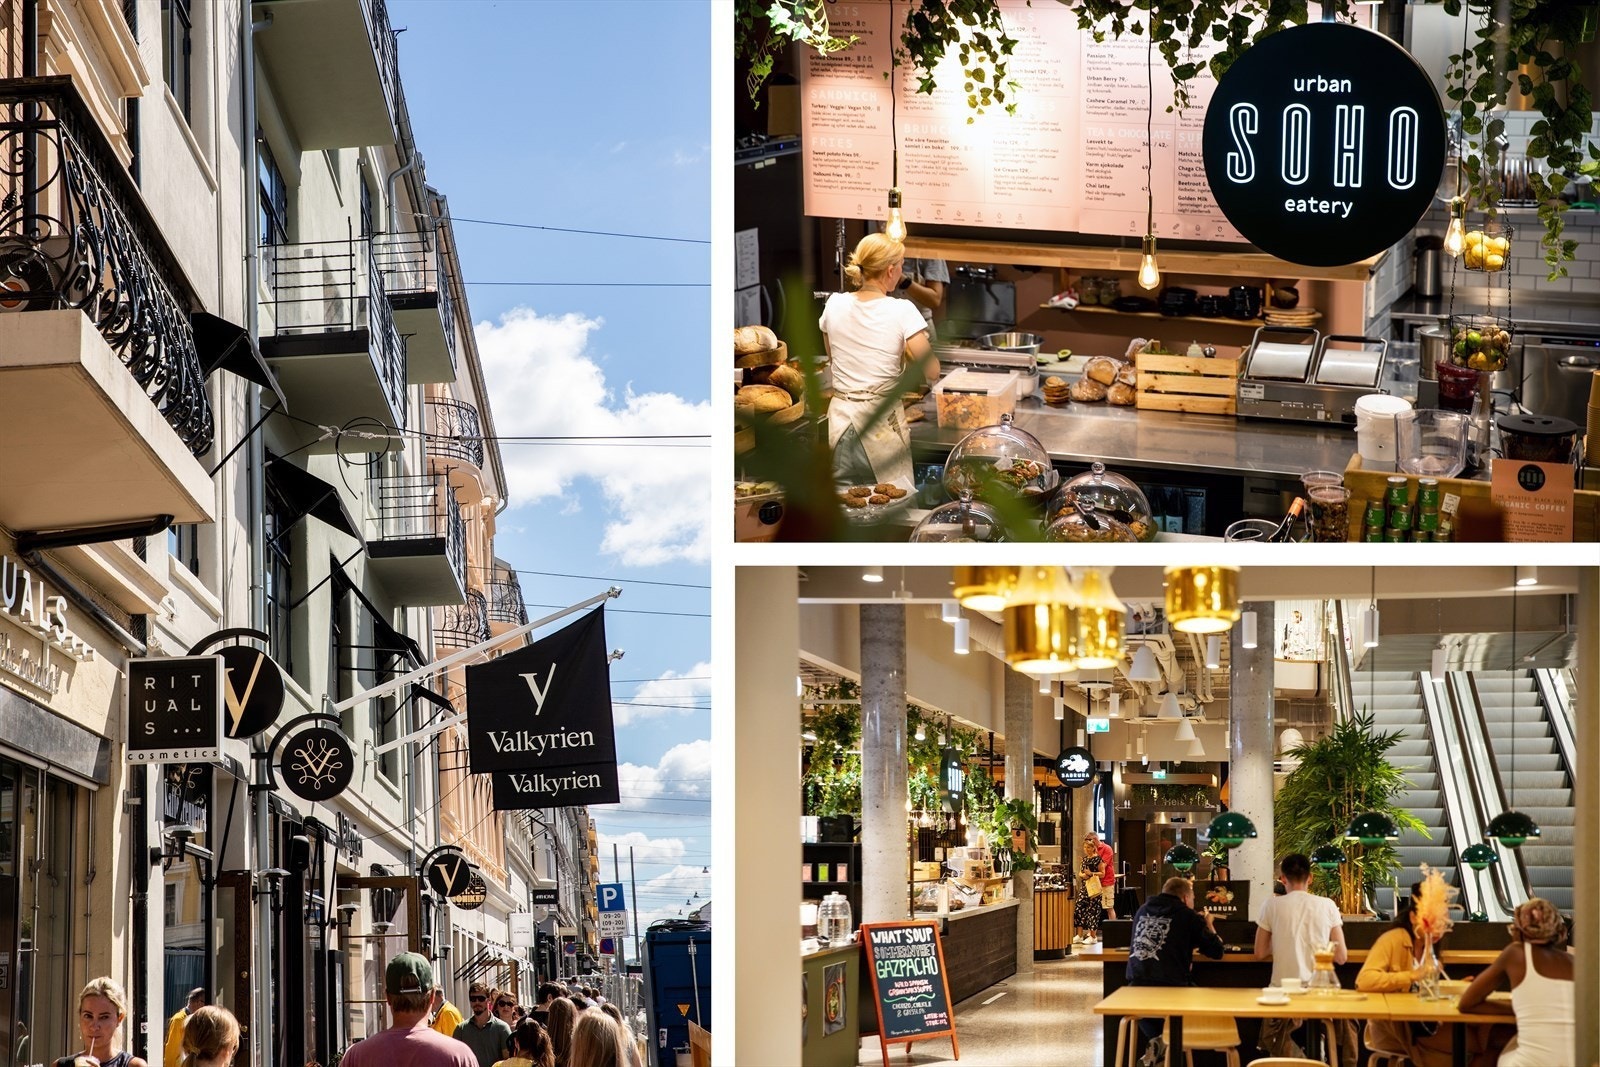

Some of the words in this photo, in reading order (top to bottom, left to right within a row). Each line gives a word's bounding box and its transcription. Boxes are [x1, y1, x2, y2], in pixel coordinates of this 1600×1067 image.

[1294, 75, 1352, 93] urban
[811, 90, 877, 102] SANDWICH
[811, 137, 853, 149] FRIES
[1227, 102, 1419, 190] SOHO
[1285, 196, 1353, 218] eatery
[1535, 504, 1566, 513] COFFEE
[487, 726, 596, 757] Valkyrien
[127, 749, 218, 761] cosmetics
[508, 771, 602, 797] Valkyrien
[602, 887, 618, 909] P
[870, 927, 933, 944] WHAT'SOUP
[876, 956, 939, 979] GAZPACHO
